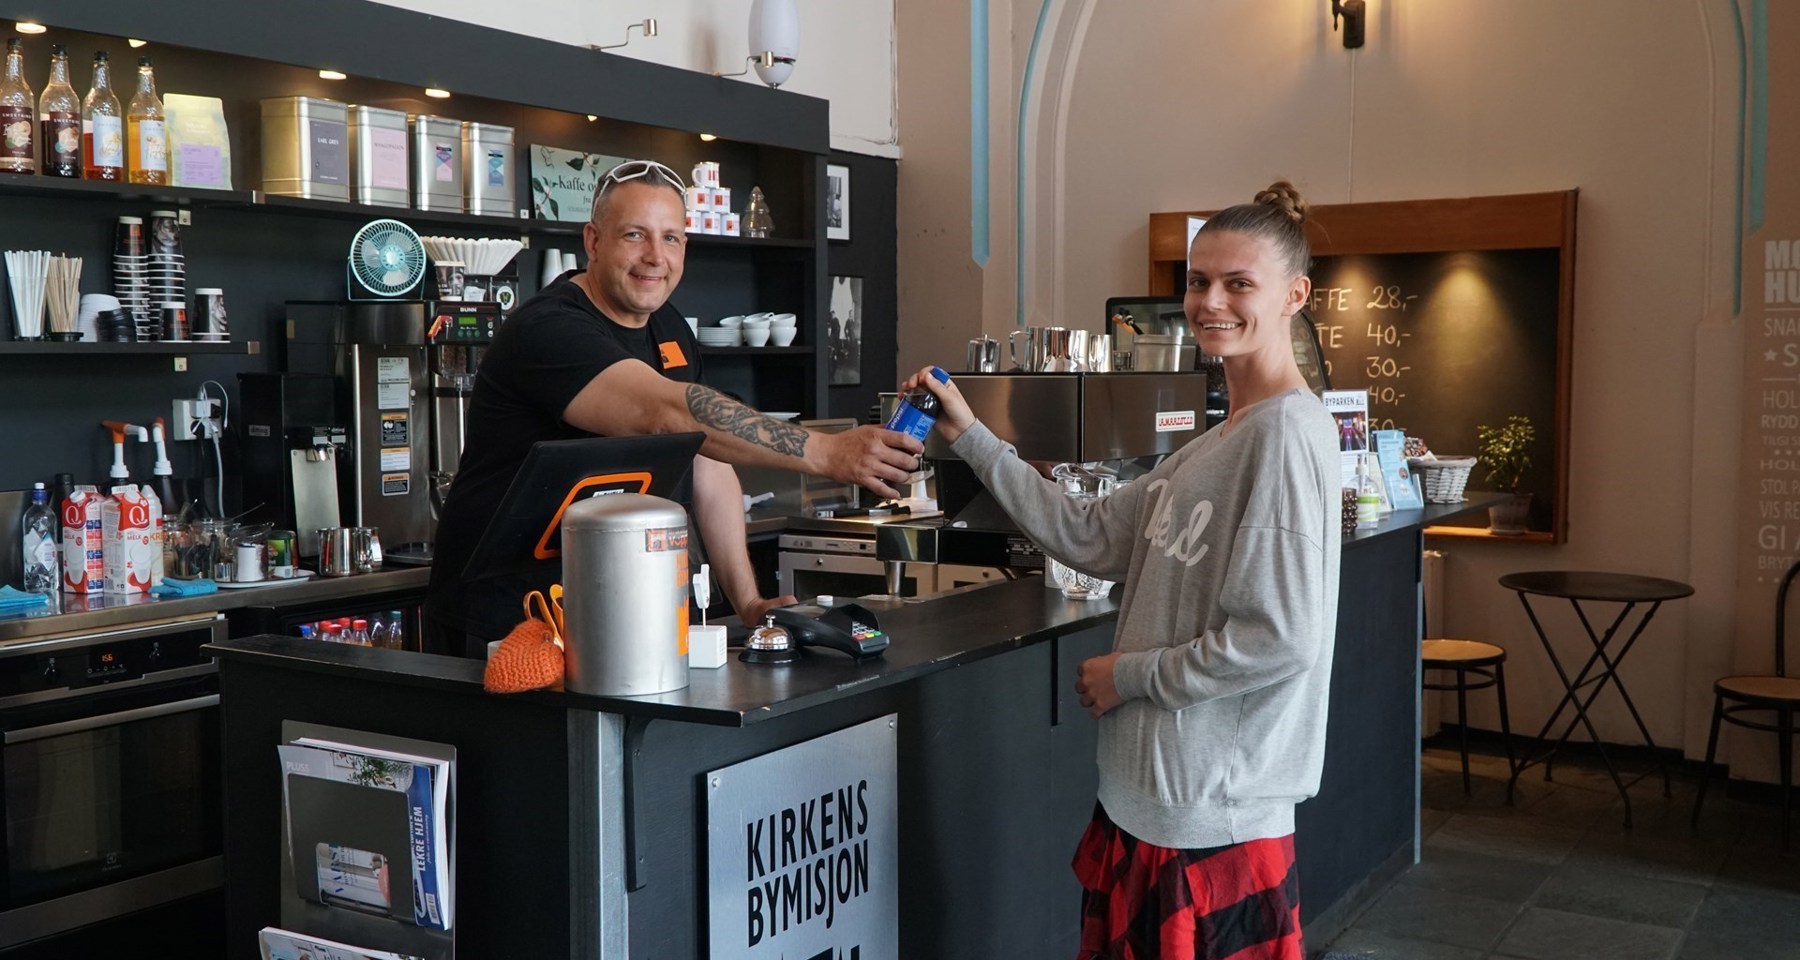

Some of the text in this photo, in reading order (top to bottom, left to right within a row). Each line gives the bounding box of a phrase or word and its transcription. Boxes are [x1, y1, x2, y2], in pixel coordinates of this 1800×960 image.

[559, 175, 596, 192] Kaffe o
[1764, 318, 1800, 336] SNA
[65, 505, 82, 525] Q
[129, 505, 148, 525] Q
[286, 761, 310, 772] PLUSS
[413, 806, 426, 872] LEKRE HJEM
[747, 780, 868, 882] KIRKENS
[747, 839, 868, 948] BYMISJON
